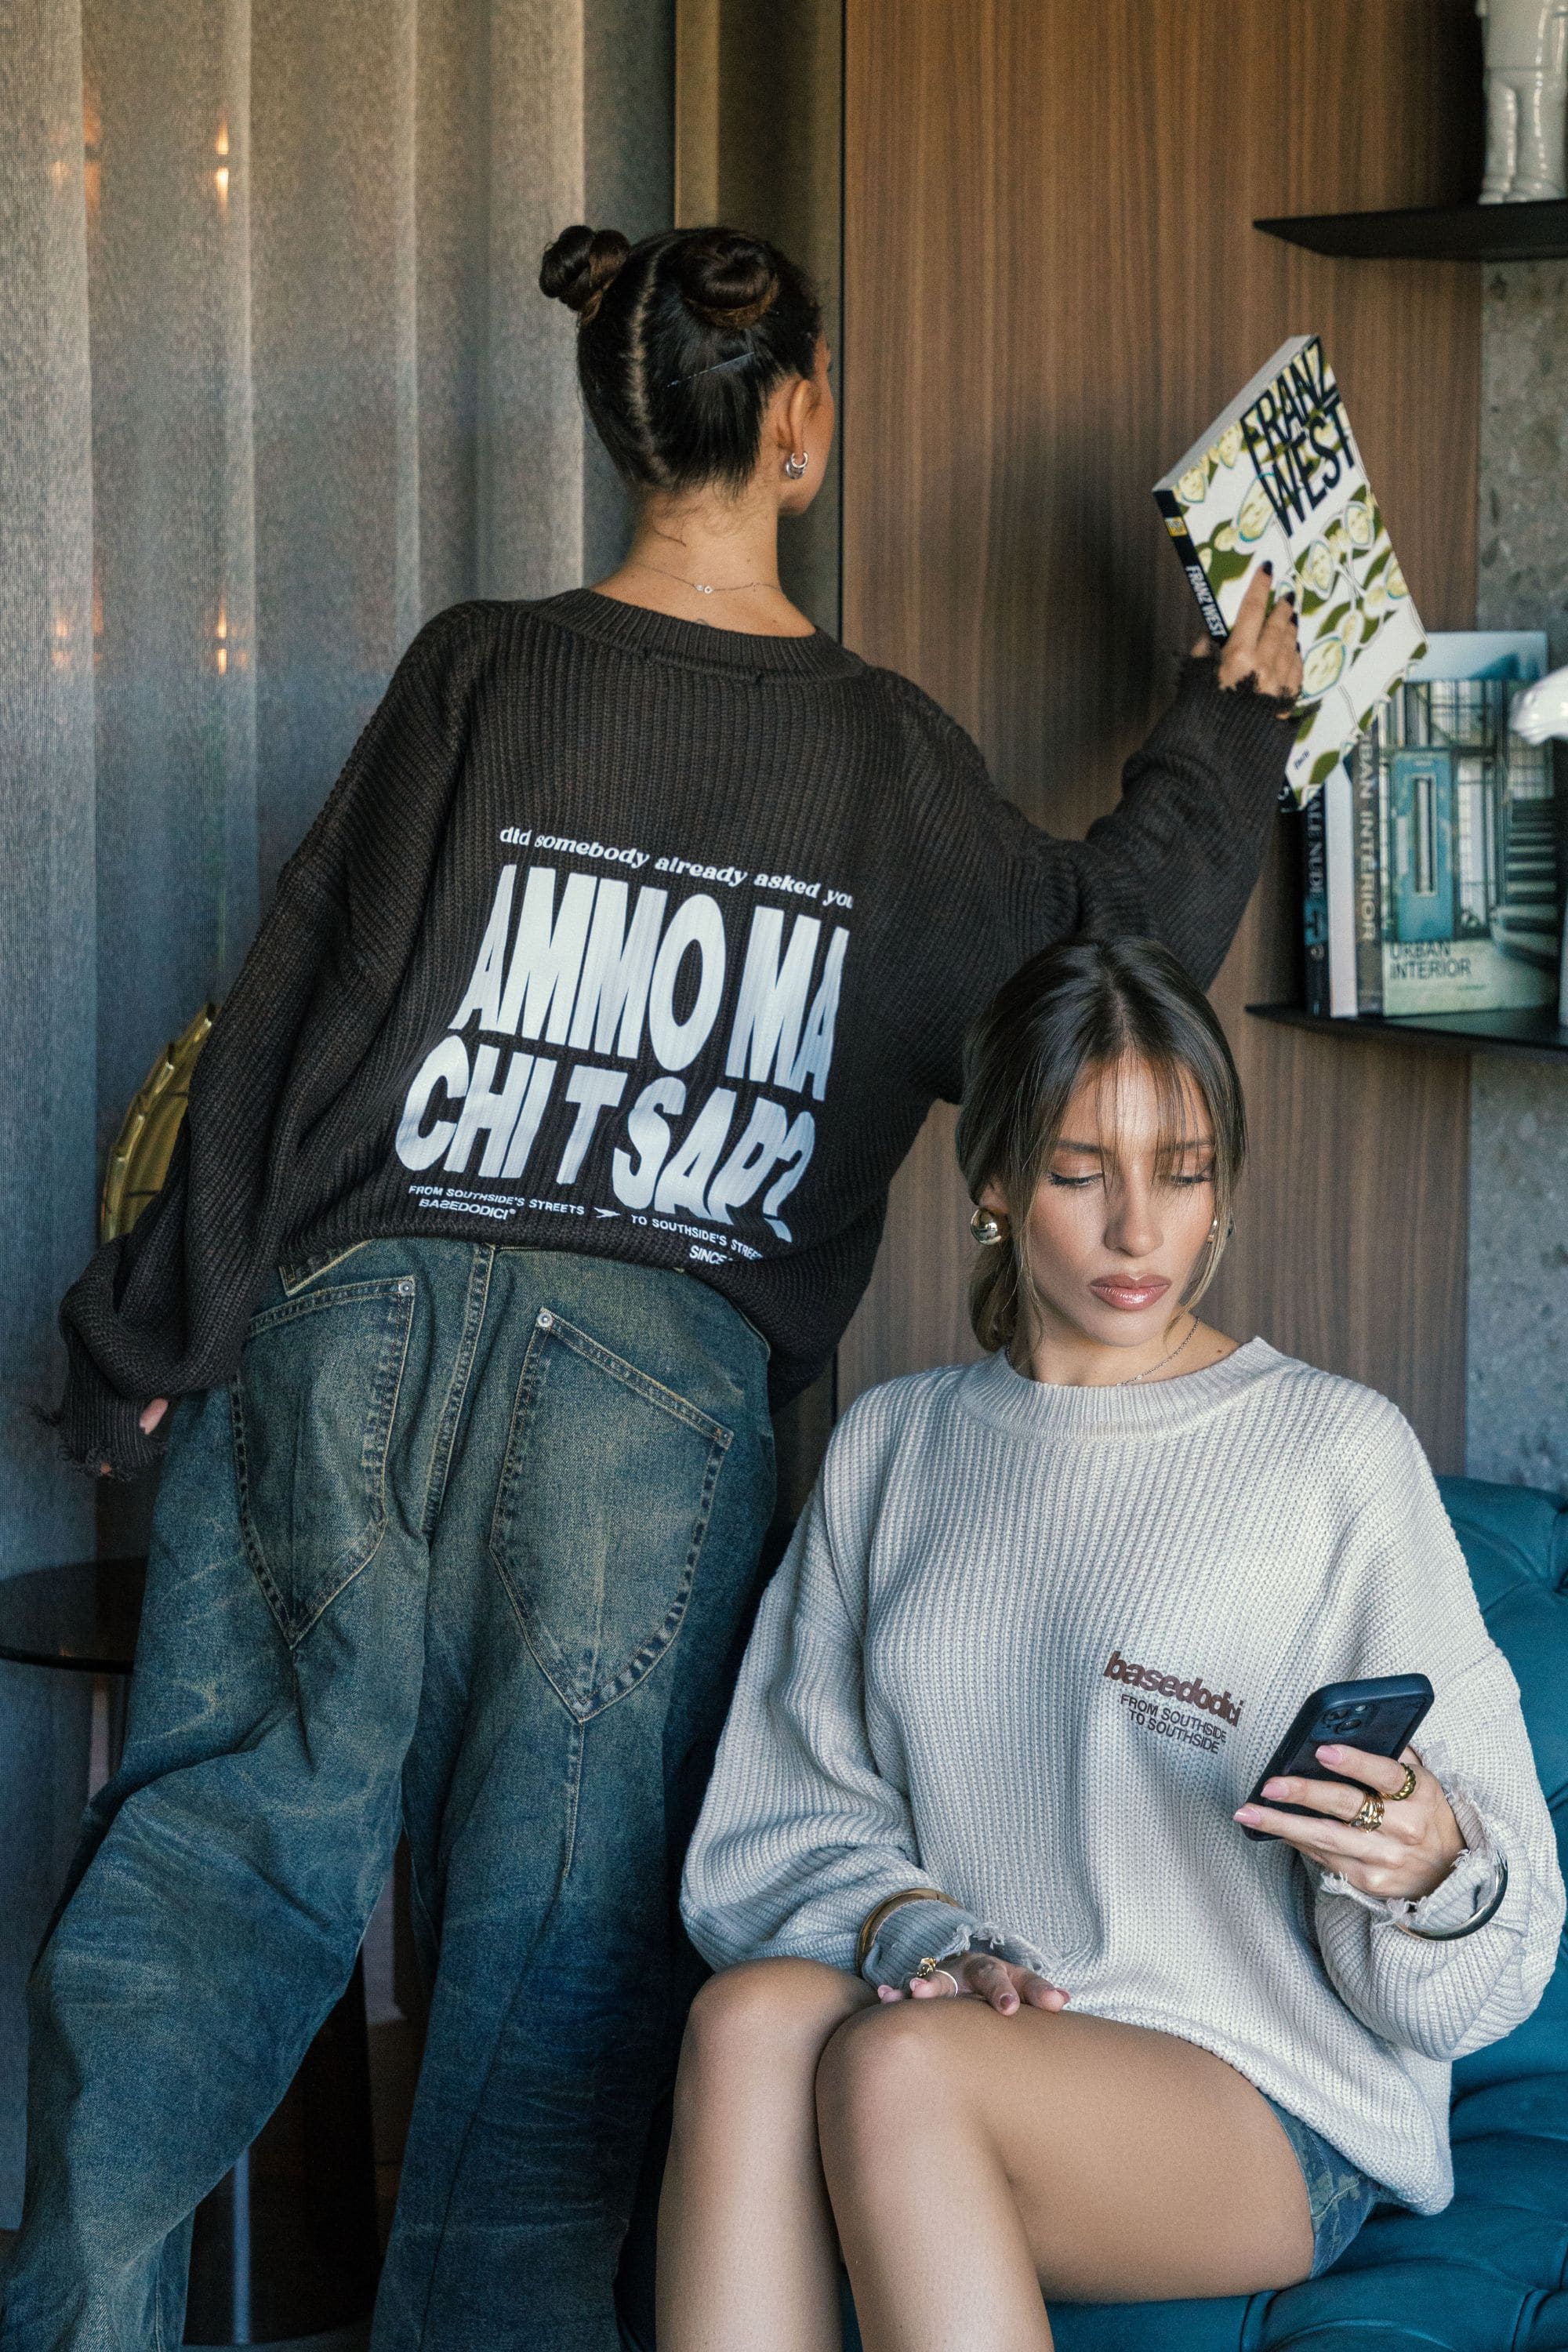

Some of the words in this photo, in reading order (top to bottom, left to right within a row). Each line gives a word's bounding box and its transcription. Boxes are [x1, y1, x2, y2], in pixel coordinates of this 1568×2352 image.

[1240, 336, 1338, 474] FRANZ
[1257, 389, 1355, 538] WEST
[1185, 564, 1214, 605] FRANZ
[1201, 603, 1229, 637] WEST
[499, 826, 532, 847] did
[534, 834, 650, 869] somebody
[654, 856, 749, 887] already
[753, 873, 822, 898] asked
[1359, 810, 1377, 941] INTERIOR
[448, 863, 727, 1072] AMMO
[724, 905, 850, 1102] MA
[1389, 956, 1472, 979] INTERIOR
[612, 1076, 815, 1243] SAP?
[408, 1185, 444, 1196] FROM
[445, 1187, 526, 1207] SOUTHSIDE'S
[528, 1198, 585, 1215] STREETS
[630, 1214, 648, 1225] TO
[652, 1218, 728, 1247] SOUTHSIDE'S
[689, 1244, 728, 1265] SINCE
[1120, 1693, 1159, 1718] FROM
[1160, 1708, 1228, 1744] SOUTHSIDE
[1129, 1709, 1145, 1726] TO
[1147, 1718, 1221, 1755] SOUTHSIDE
